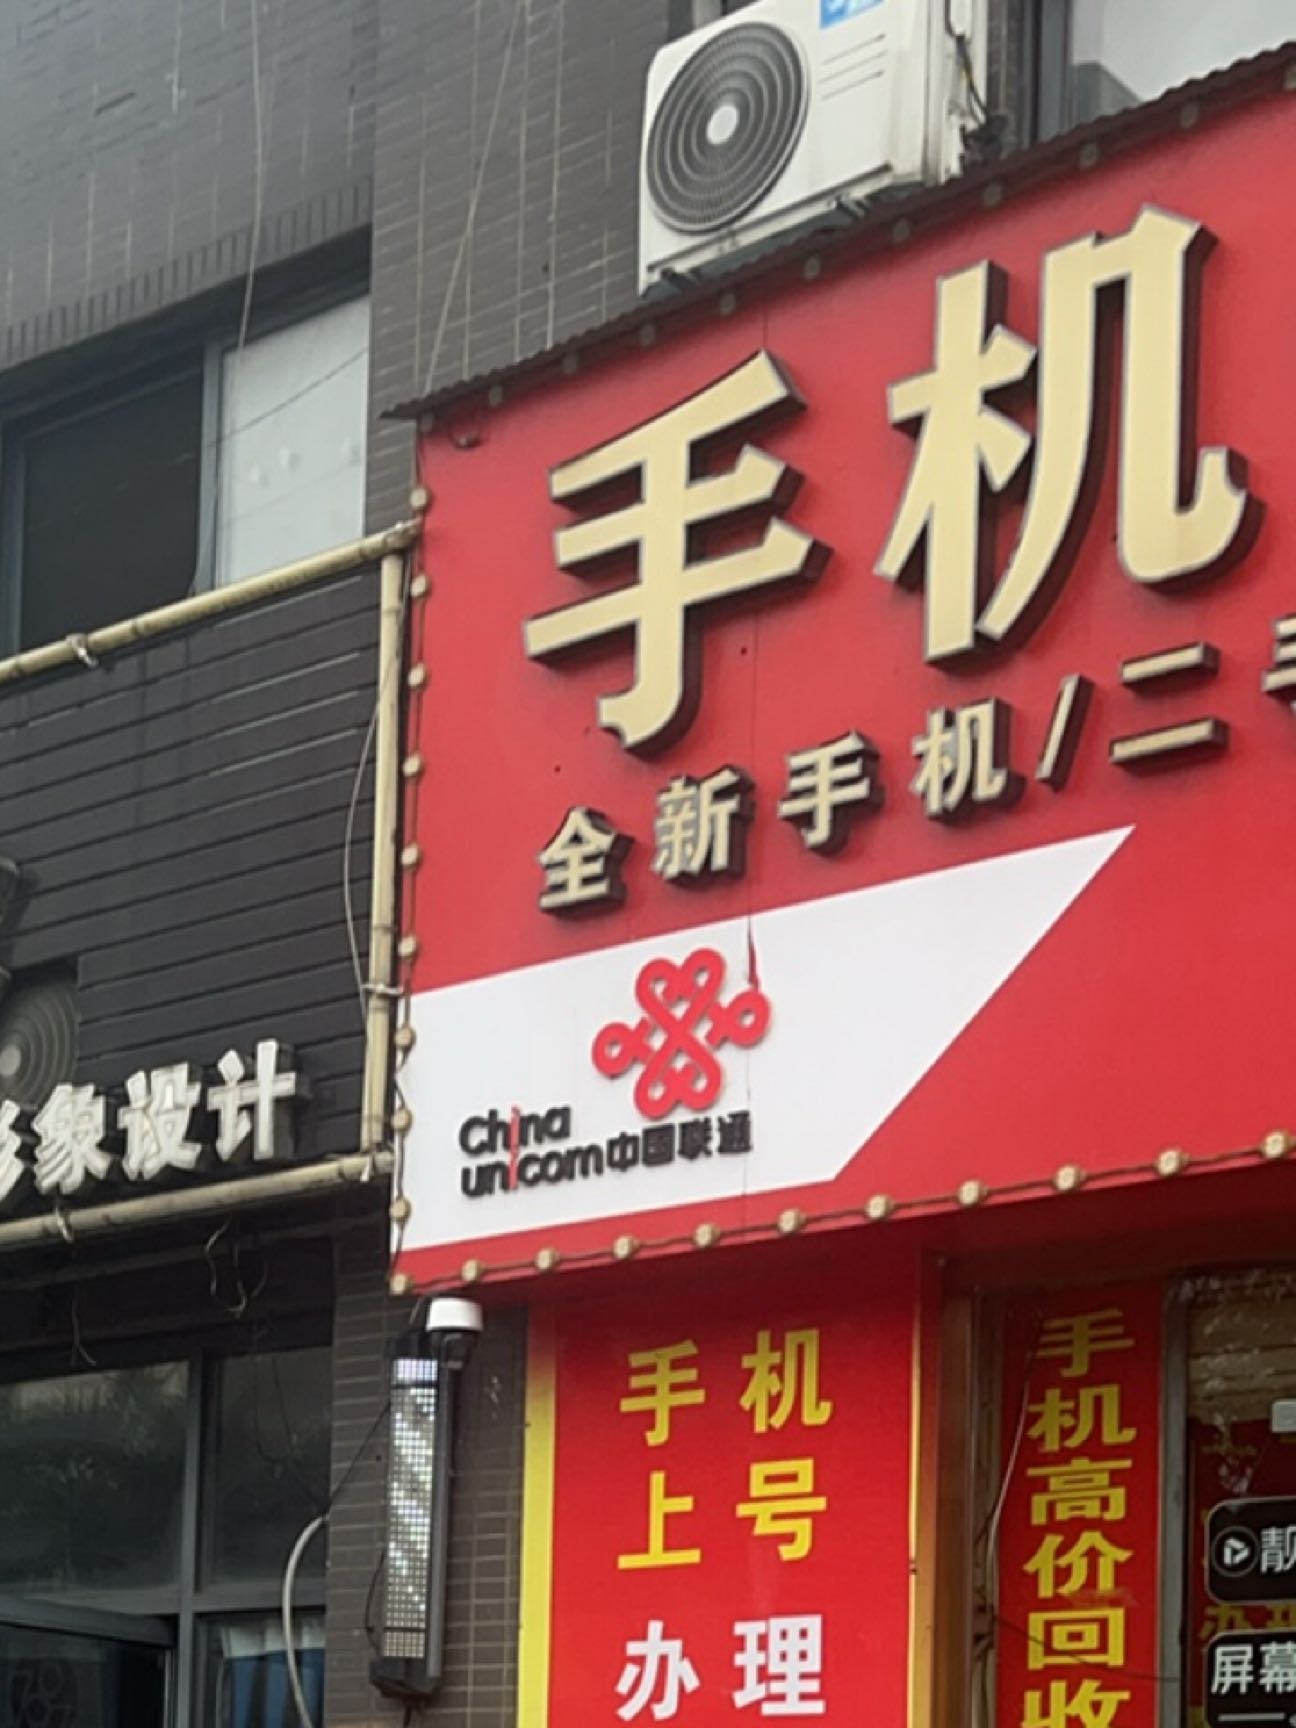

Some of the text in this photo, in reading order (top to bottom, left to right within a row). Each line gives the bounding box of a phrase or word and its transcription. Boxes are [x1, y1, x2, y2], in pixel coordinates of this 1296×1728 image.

[522, 202, 1252, 754] 手机
[606, 1111, 753, 1172] 中国联通
[620, 1328, 834, 1448] 手机
[616, 1457, 828, 1570] 上号
[613, 1613, 828, 1722] 办理
[1210, 1640, 1296, 1696] 屏幕
